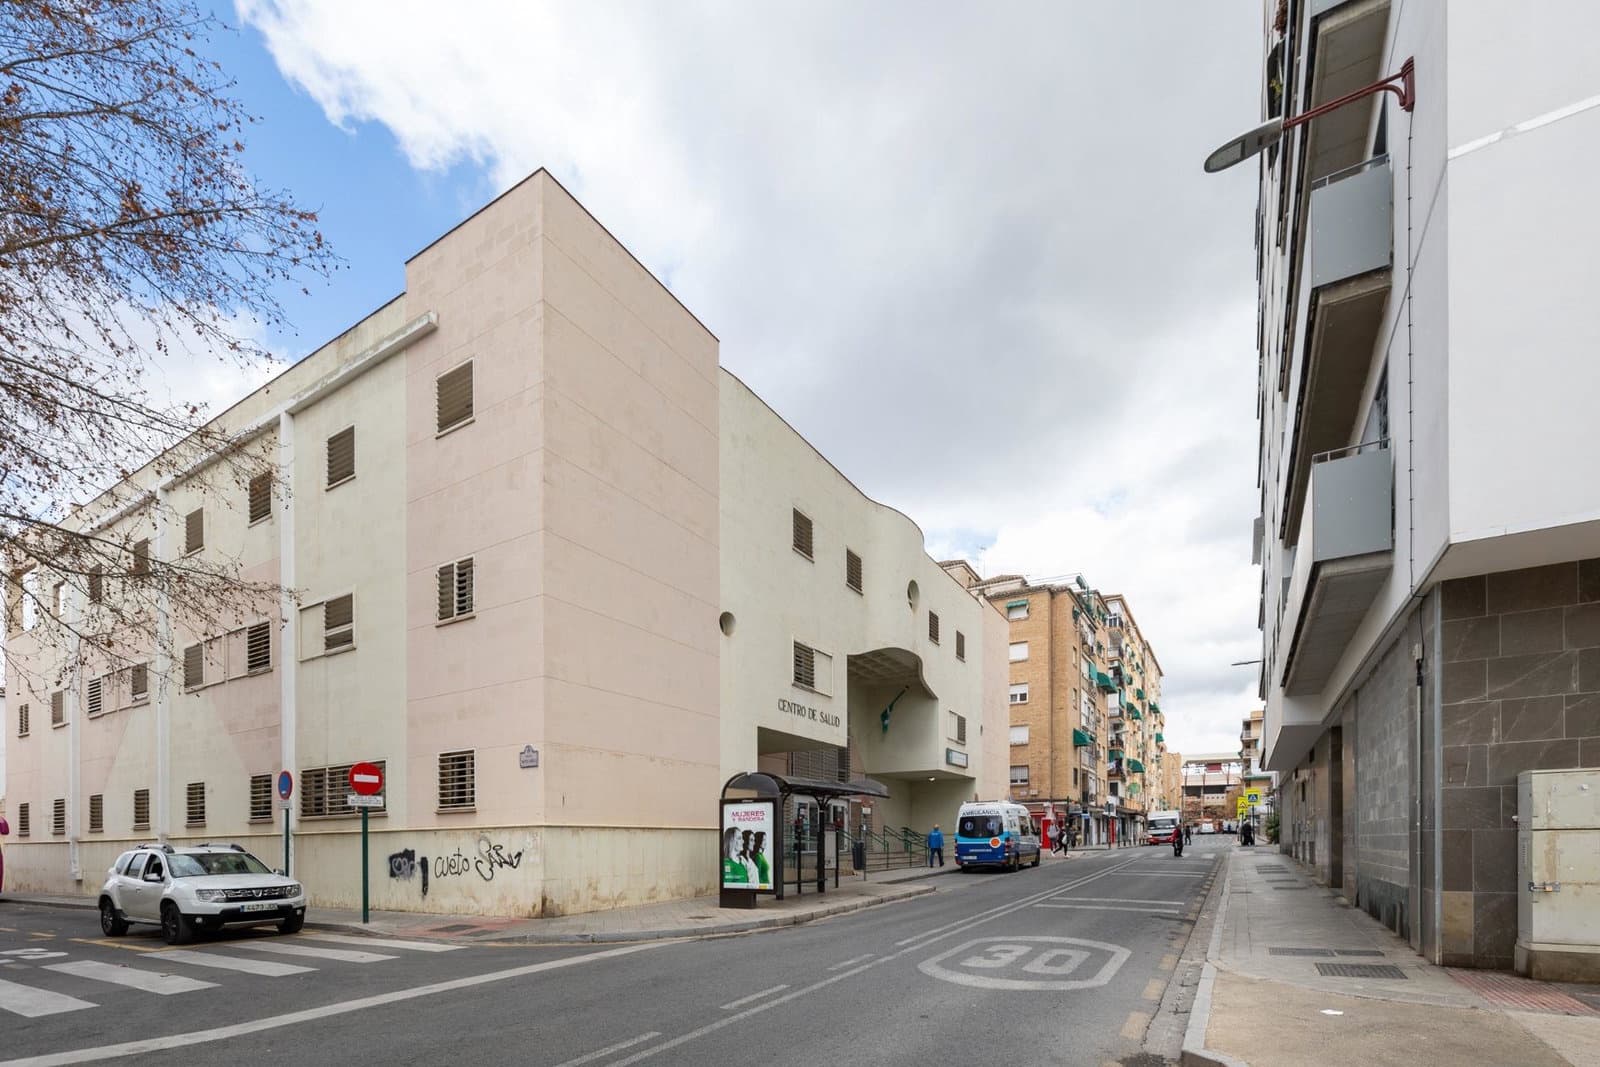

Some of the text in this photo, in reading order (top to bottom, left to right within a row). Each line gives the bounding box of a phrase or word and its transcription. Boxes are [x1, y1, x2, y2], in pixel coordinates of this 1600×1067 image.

[778, 698, 841, 728] CENTRO DE SALUD
[960, 945, 1091, 974] 30
